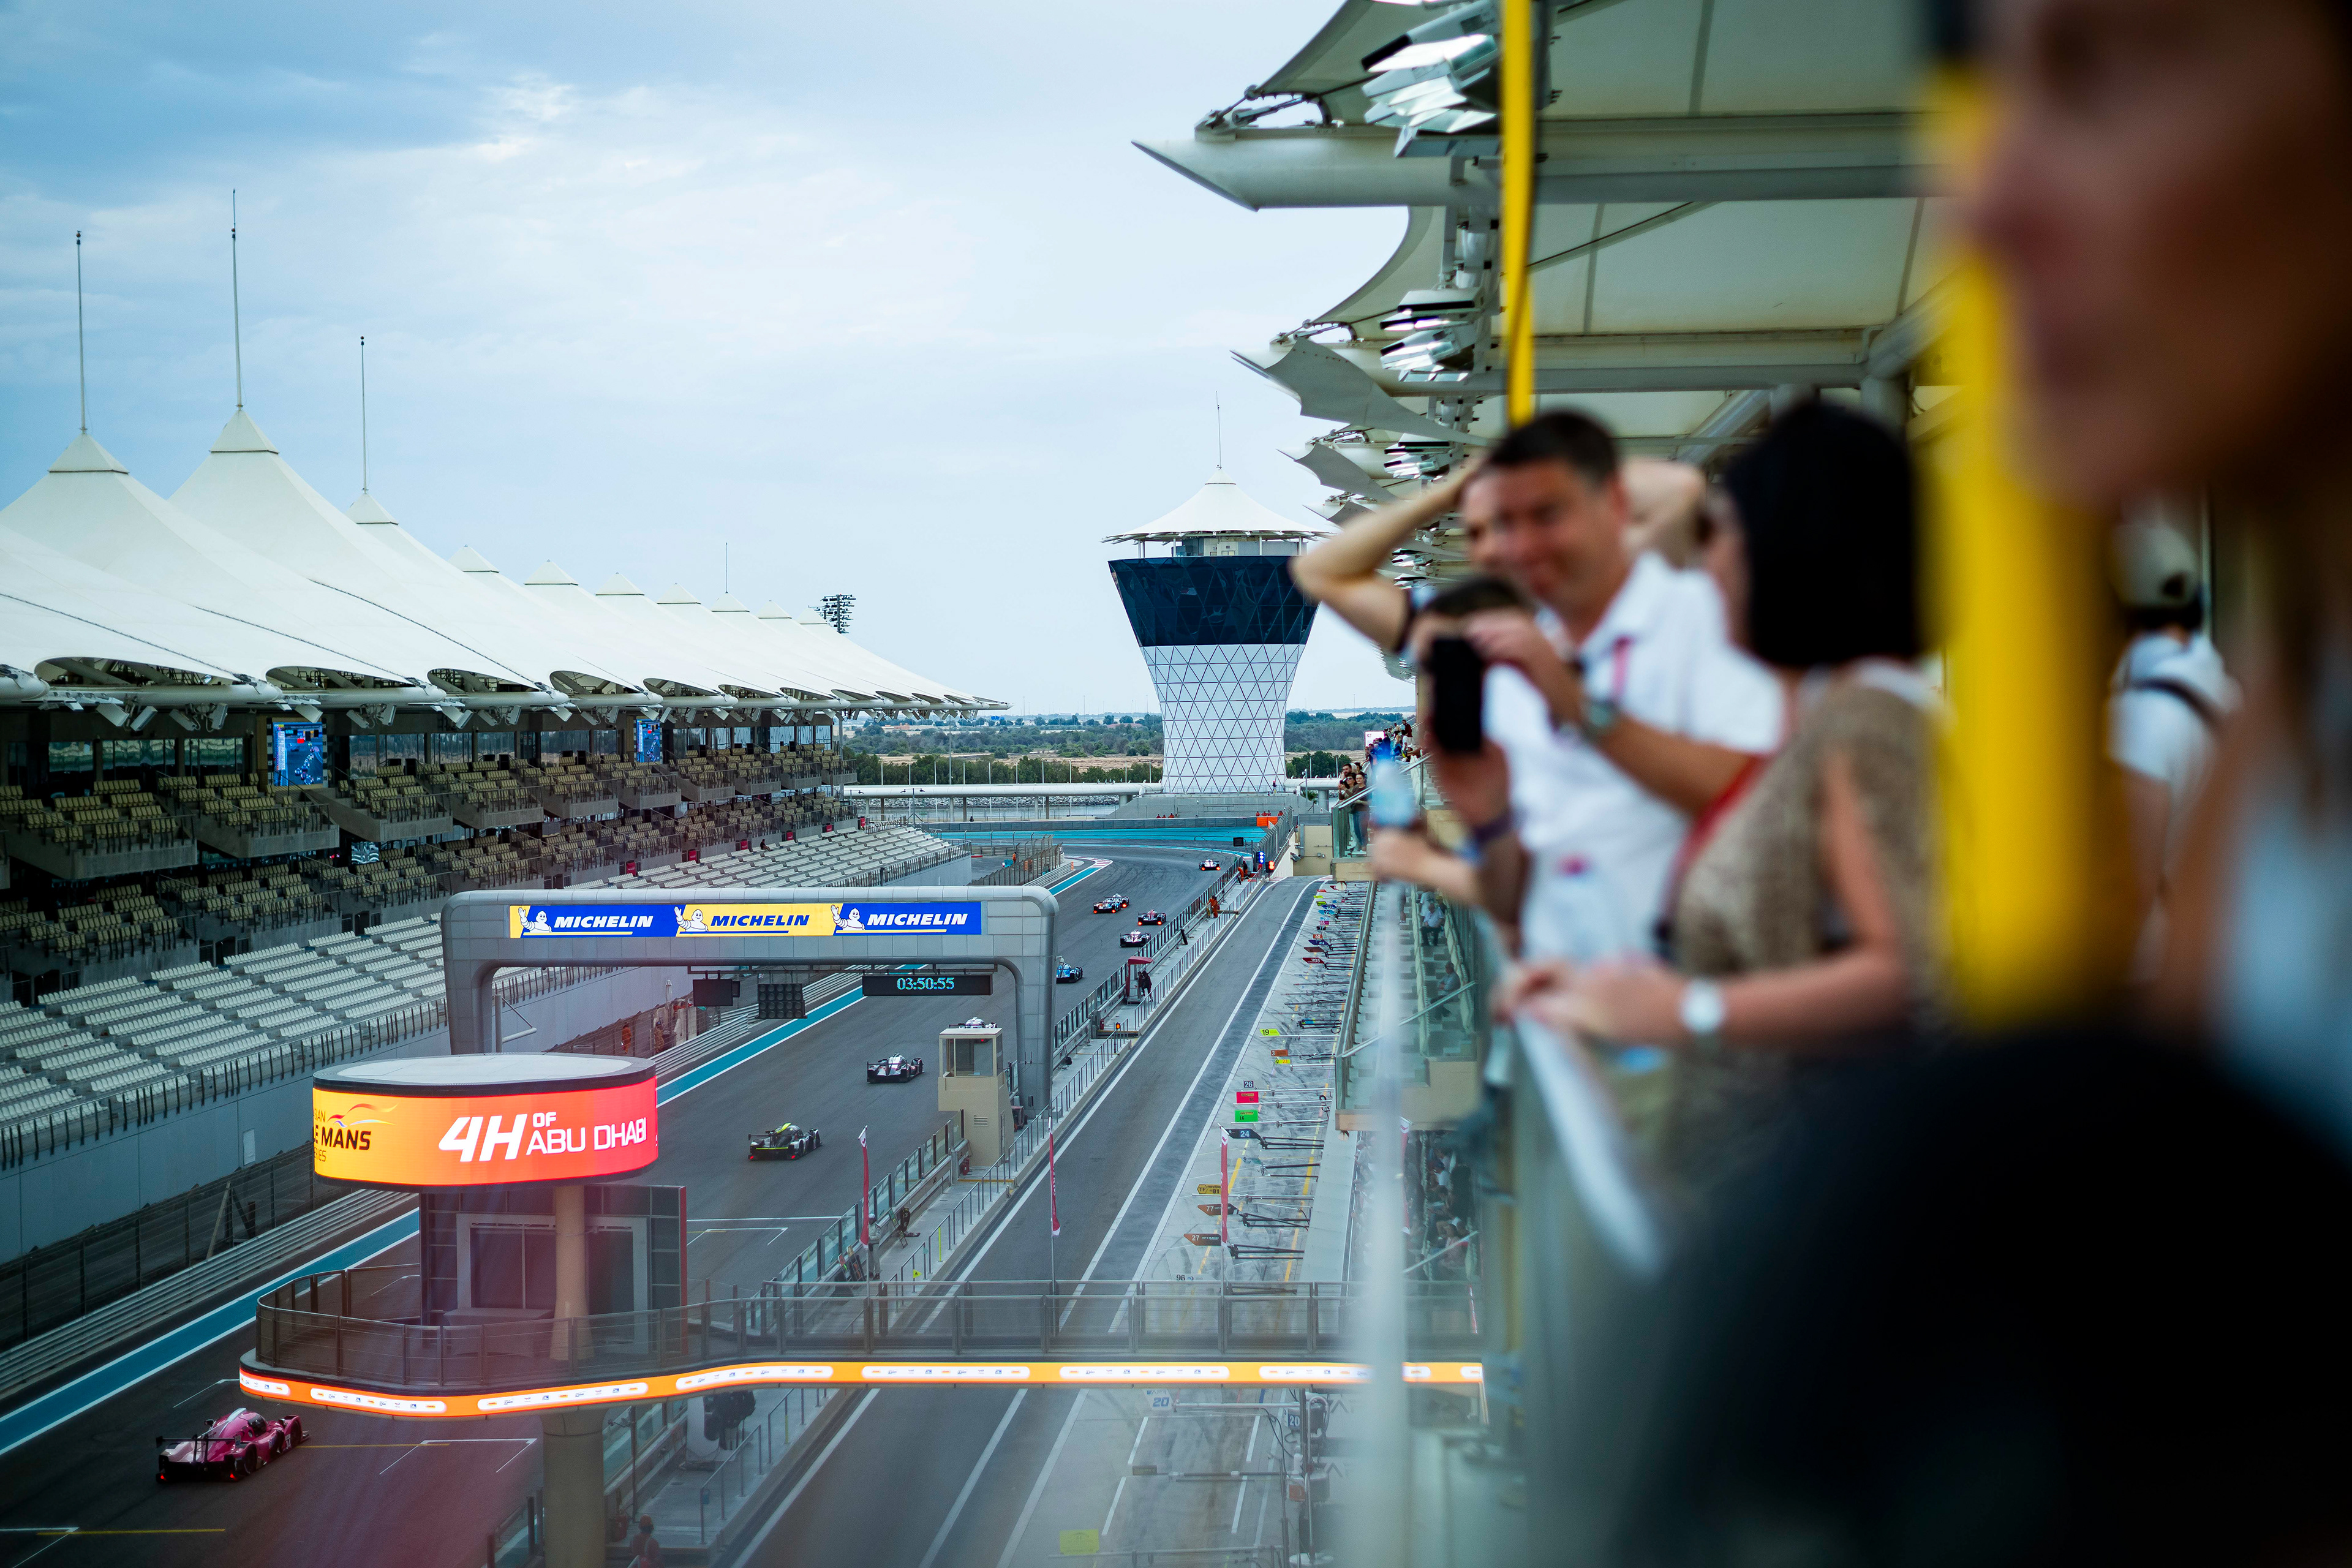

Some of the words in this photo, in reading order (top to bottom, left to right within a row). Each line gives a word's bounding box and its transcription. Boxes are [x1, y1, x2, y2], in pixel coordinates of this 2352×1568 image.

[554, 916, 653, 928] MICHELIN
[710, 914, 810, 926] MICHELIN
[867, 913, 968, 925] MICHELIN
[897, 978, 954, 990] 03:50:55
[313, 1108, 326, 1122] SIAN
[532, 1112, 556, 1127] OF
[321, 1126, 371, 1150] MANS
[438, 1113, 527, 1162] 4H
[526, 1127, 586, 1155] ABU
[593, 1117, 646, 1150] DHABI
[1153, 1397, 1170, 1408] 20
[1289, 1415, 1300, 1427] 20
